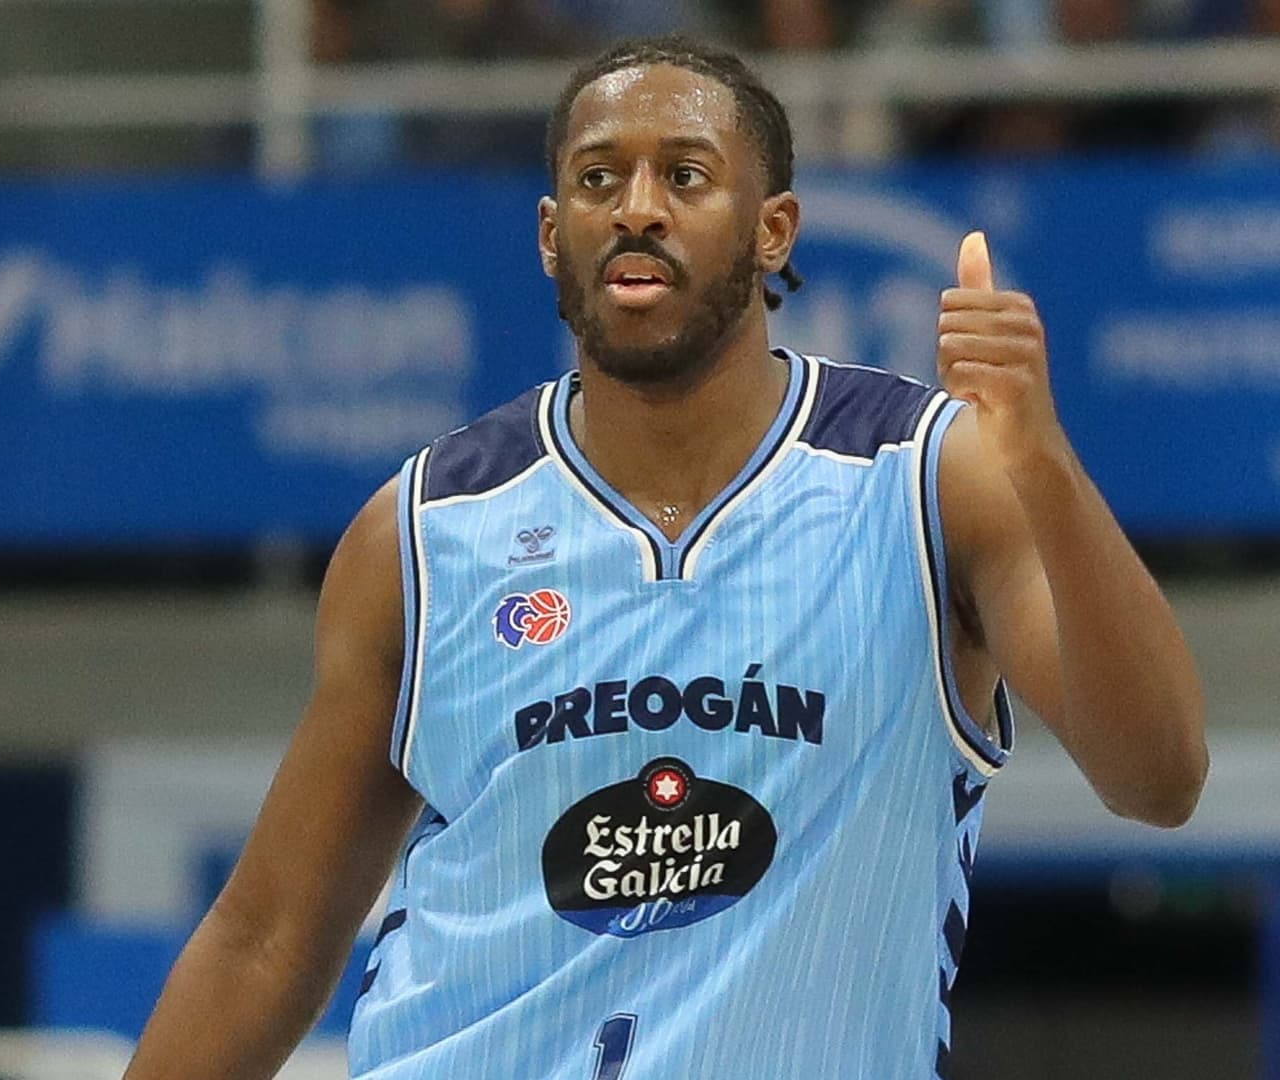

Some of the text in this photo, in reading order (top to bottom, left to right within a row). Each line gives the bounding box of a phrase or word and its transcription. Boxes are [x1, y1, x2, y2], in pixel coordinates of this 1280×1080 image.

[515, 663, 826, 753] BREOGÁN
[583, 812, 741, 858] Estrella
[583, 854, 726, 901] Galicia
